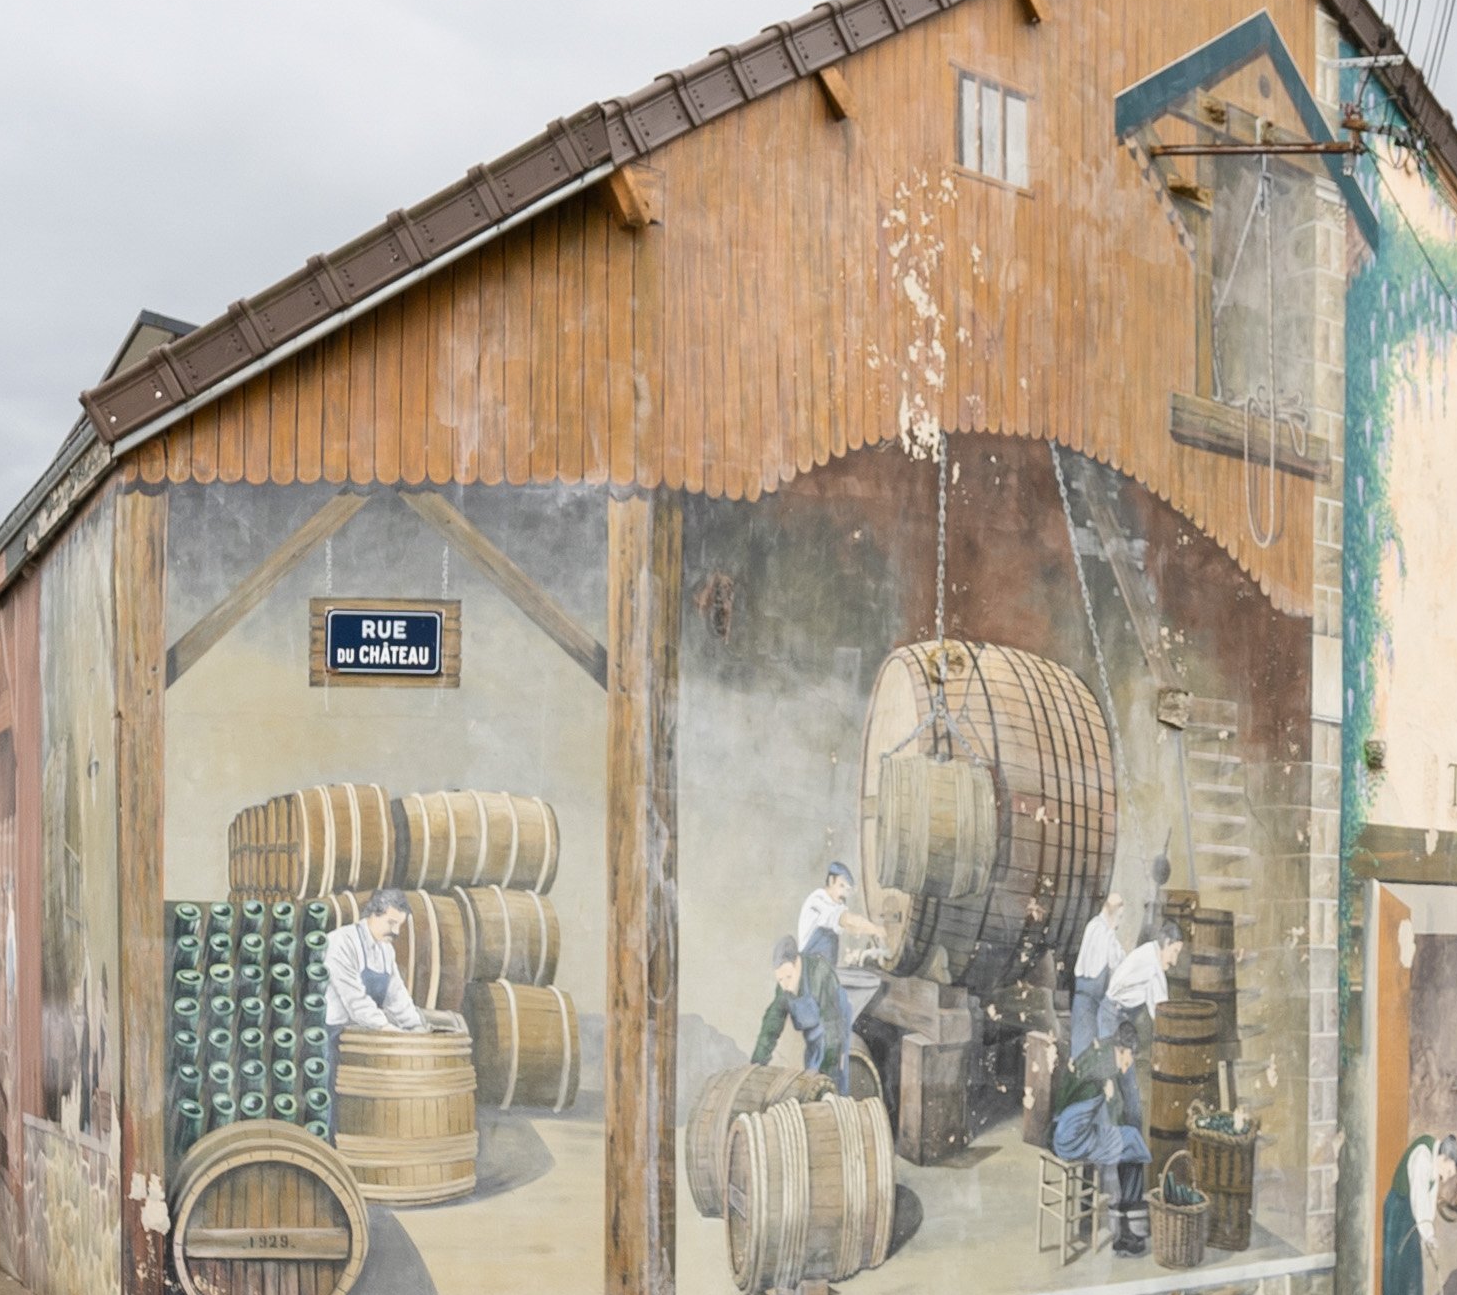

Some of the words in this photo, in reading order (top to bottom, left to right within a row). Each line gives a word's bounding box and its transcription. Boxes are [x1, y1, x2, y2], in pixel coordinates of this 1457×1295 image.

[361, 619, 407, 640] RUE
[336, 647, 355, 664] DU
[358, 641, 430, 665] CHÂTEAU
